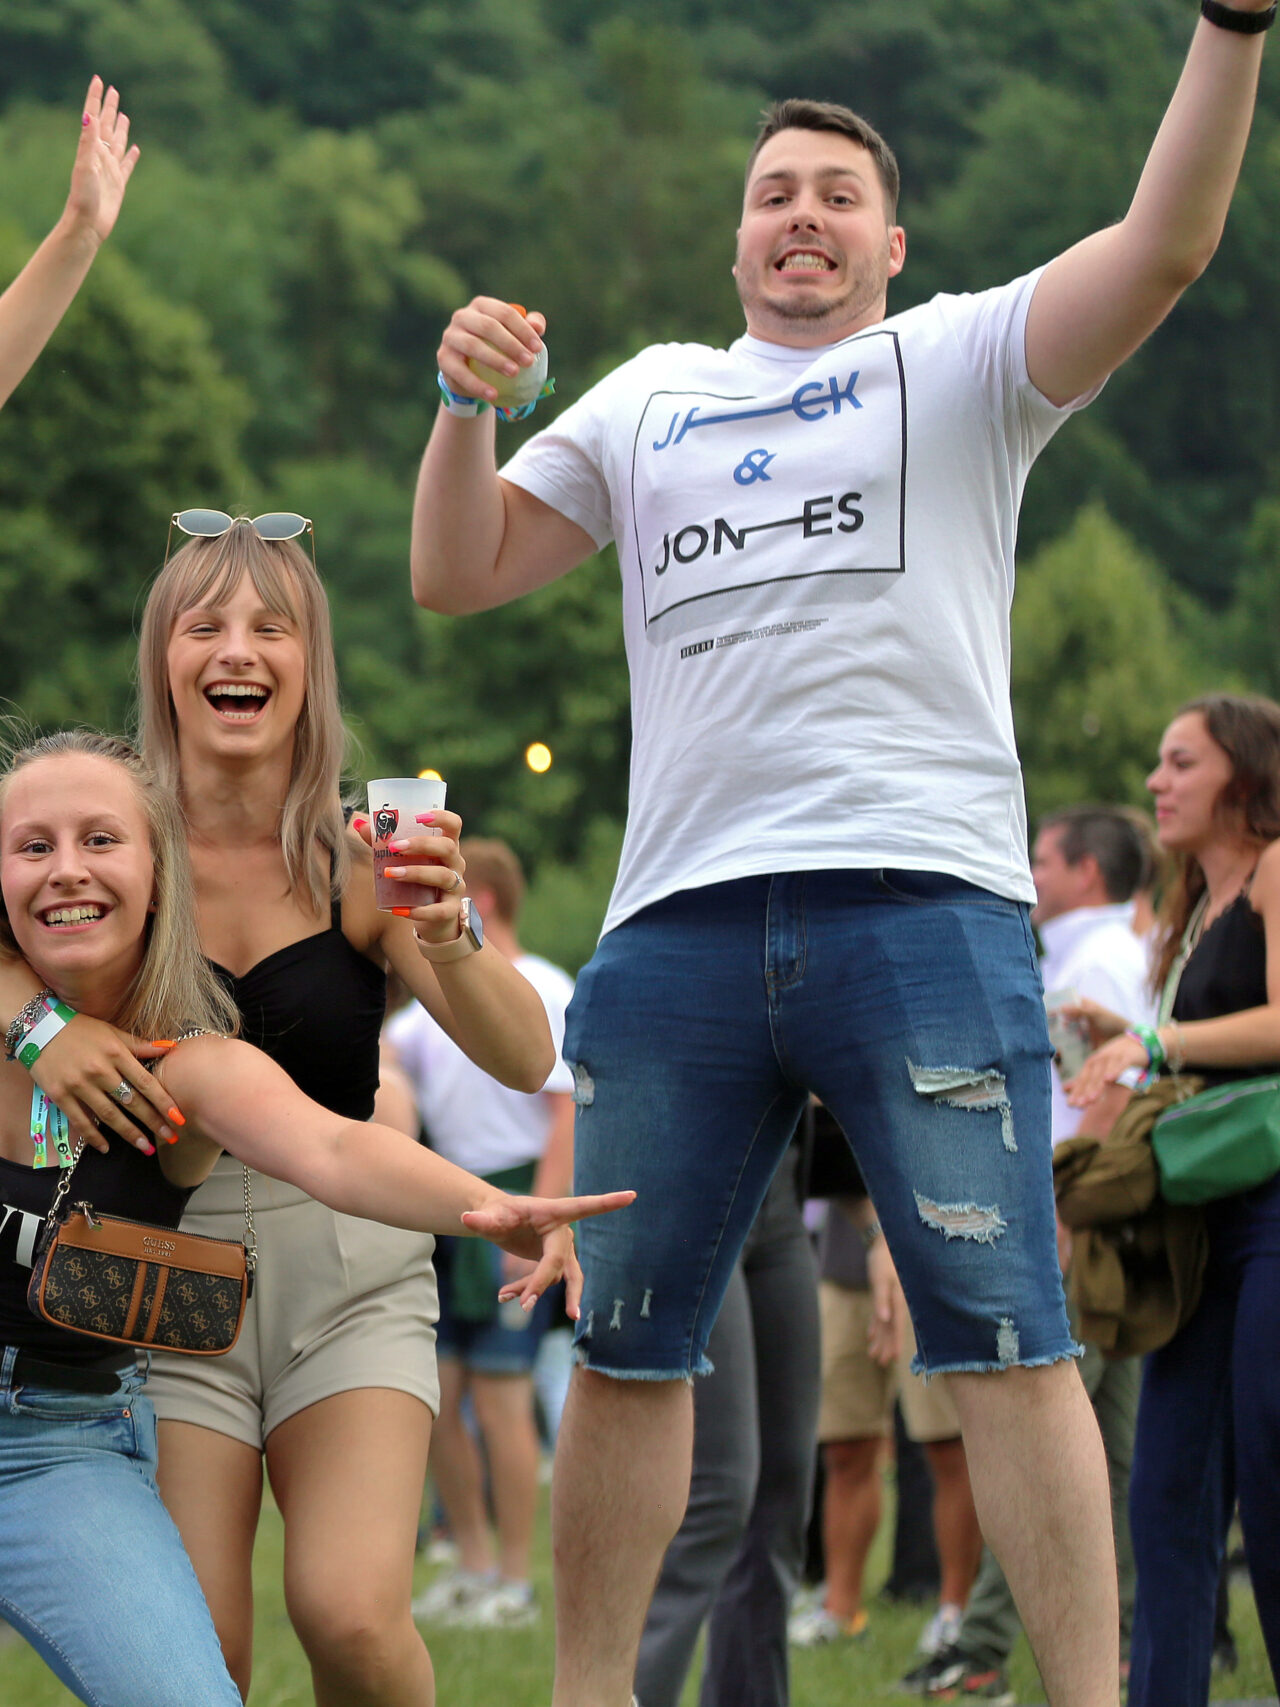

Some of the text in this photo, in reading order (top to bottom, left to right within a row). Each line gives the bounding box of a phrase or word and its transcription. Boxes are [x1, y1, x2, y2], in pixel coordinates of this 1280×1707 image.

[733, 448, 777, 486] &
[654, 491, 865, 576] JONES
[143, 1235, 176, 1251] GUESS
